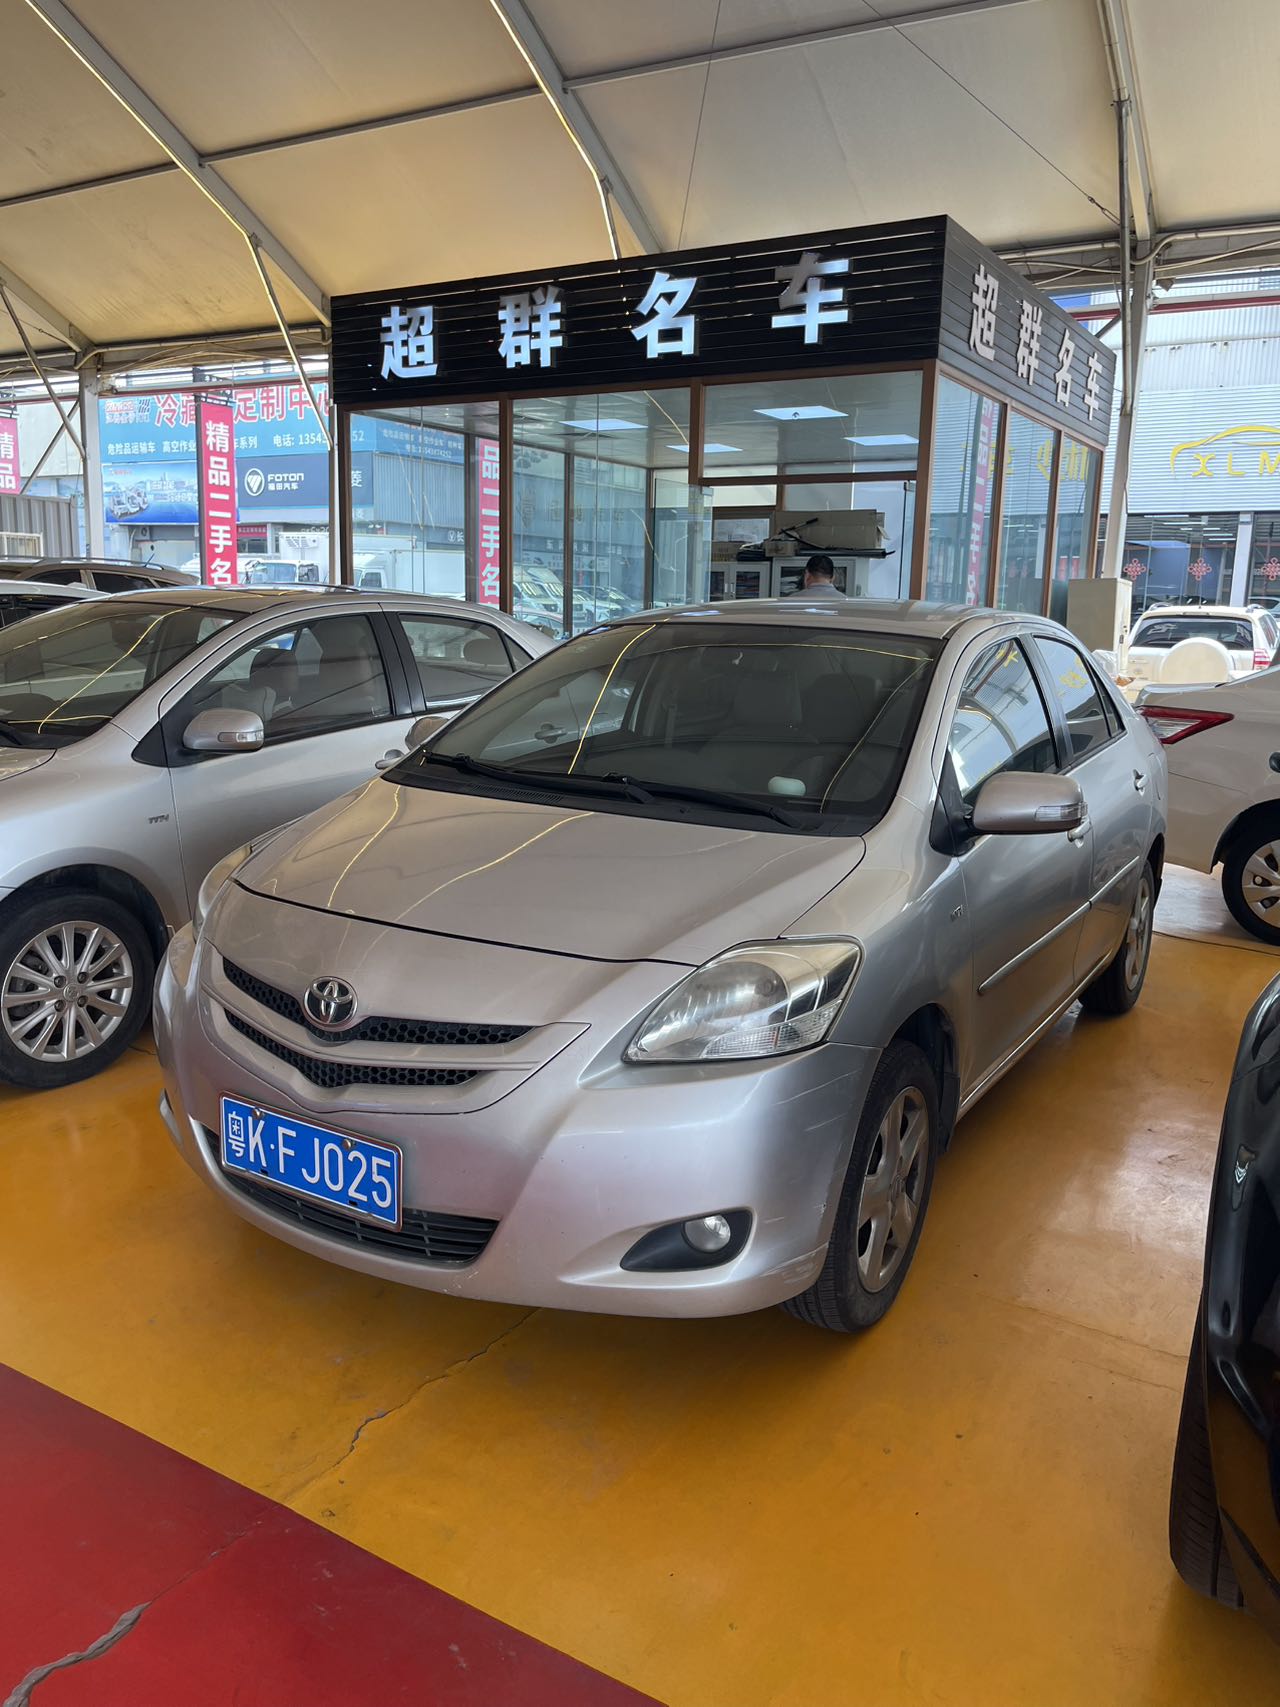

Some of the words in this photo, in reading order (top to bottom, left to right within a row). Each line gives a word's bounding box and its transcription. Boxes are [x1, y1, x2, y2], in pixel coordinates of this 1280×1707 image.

[380, 251, 850, 380] 超群名车
[968, 264, 1102, 421] 超群名车
[267, 472, 305, 482] FOTON
